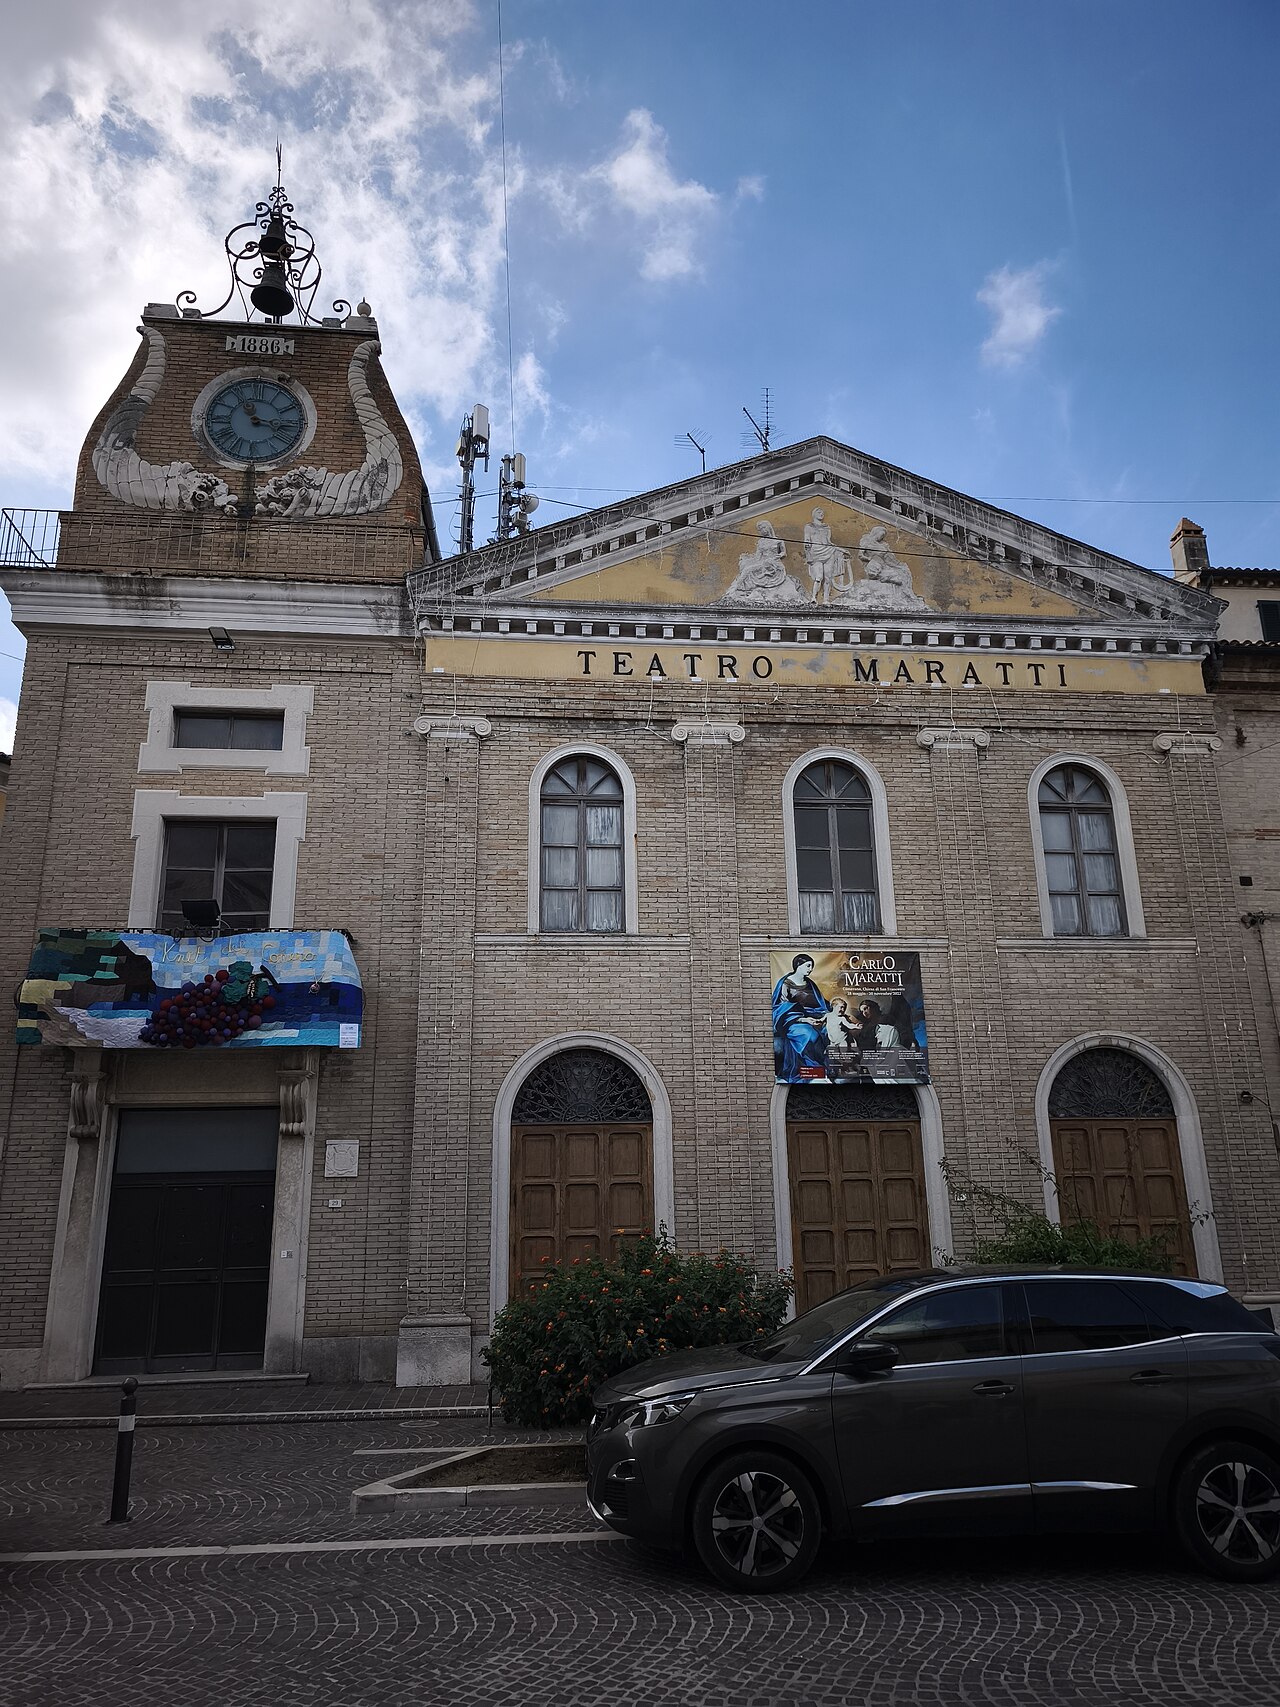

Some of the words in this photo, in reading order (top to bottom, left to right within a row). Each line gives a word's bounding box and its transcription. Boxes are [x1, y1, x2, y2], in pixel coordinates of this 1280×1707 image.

[240, 337, 280, 354] 1886
[577, 651, 773, 679] TEATRO
[852, 658, 1067, 687] MARATTI
[162, 941, 209, 964] Knit
[849, 956, 895, 970] CARLO
[844, 973, 903, 987] MARATTI
